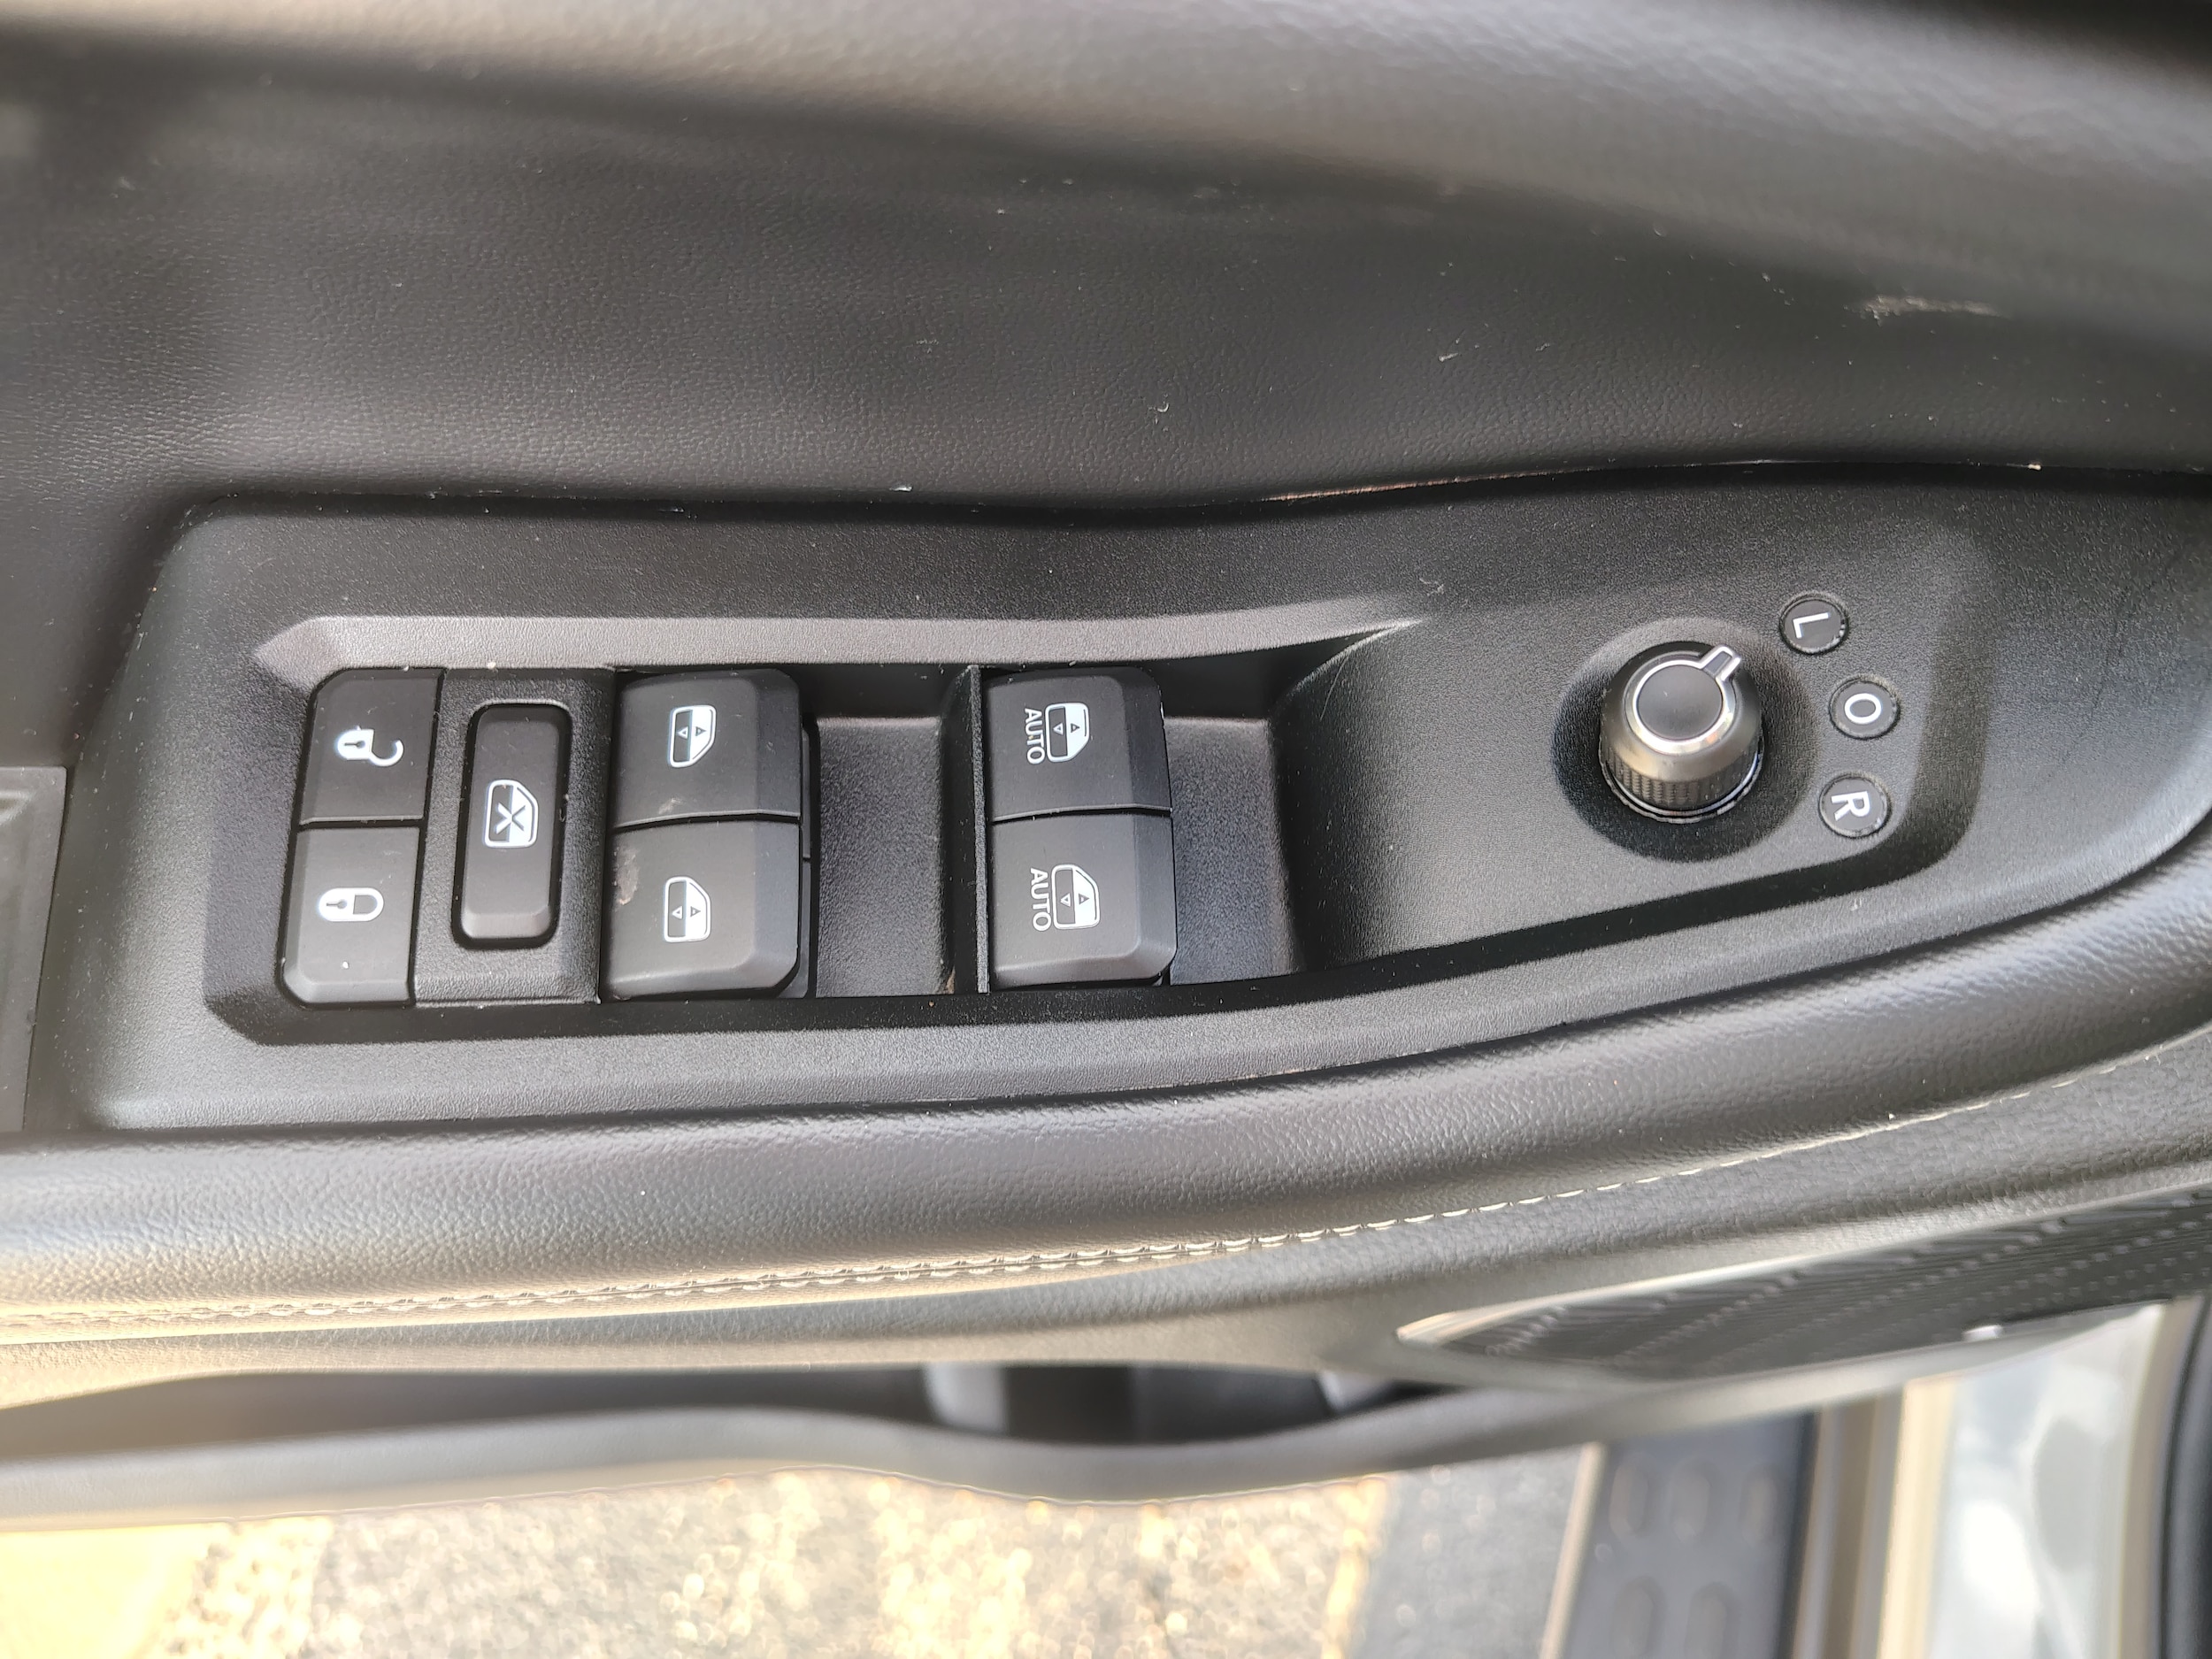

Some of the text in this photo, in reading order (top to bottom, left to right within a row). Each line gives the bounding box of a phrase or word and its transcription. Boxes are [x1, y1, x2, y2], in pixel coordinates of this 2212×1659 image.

[1792, 611, 1830, 639] L
[1024, 707, 1046, 764] AUTO
[1831, 790, 1871, 822] R
[1029, 868, 1052, 933] AUTO
